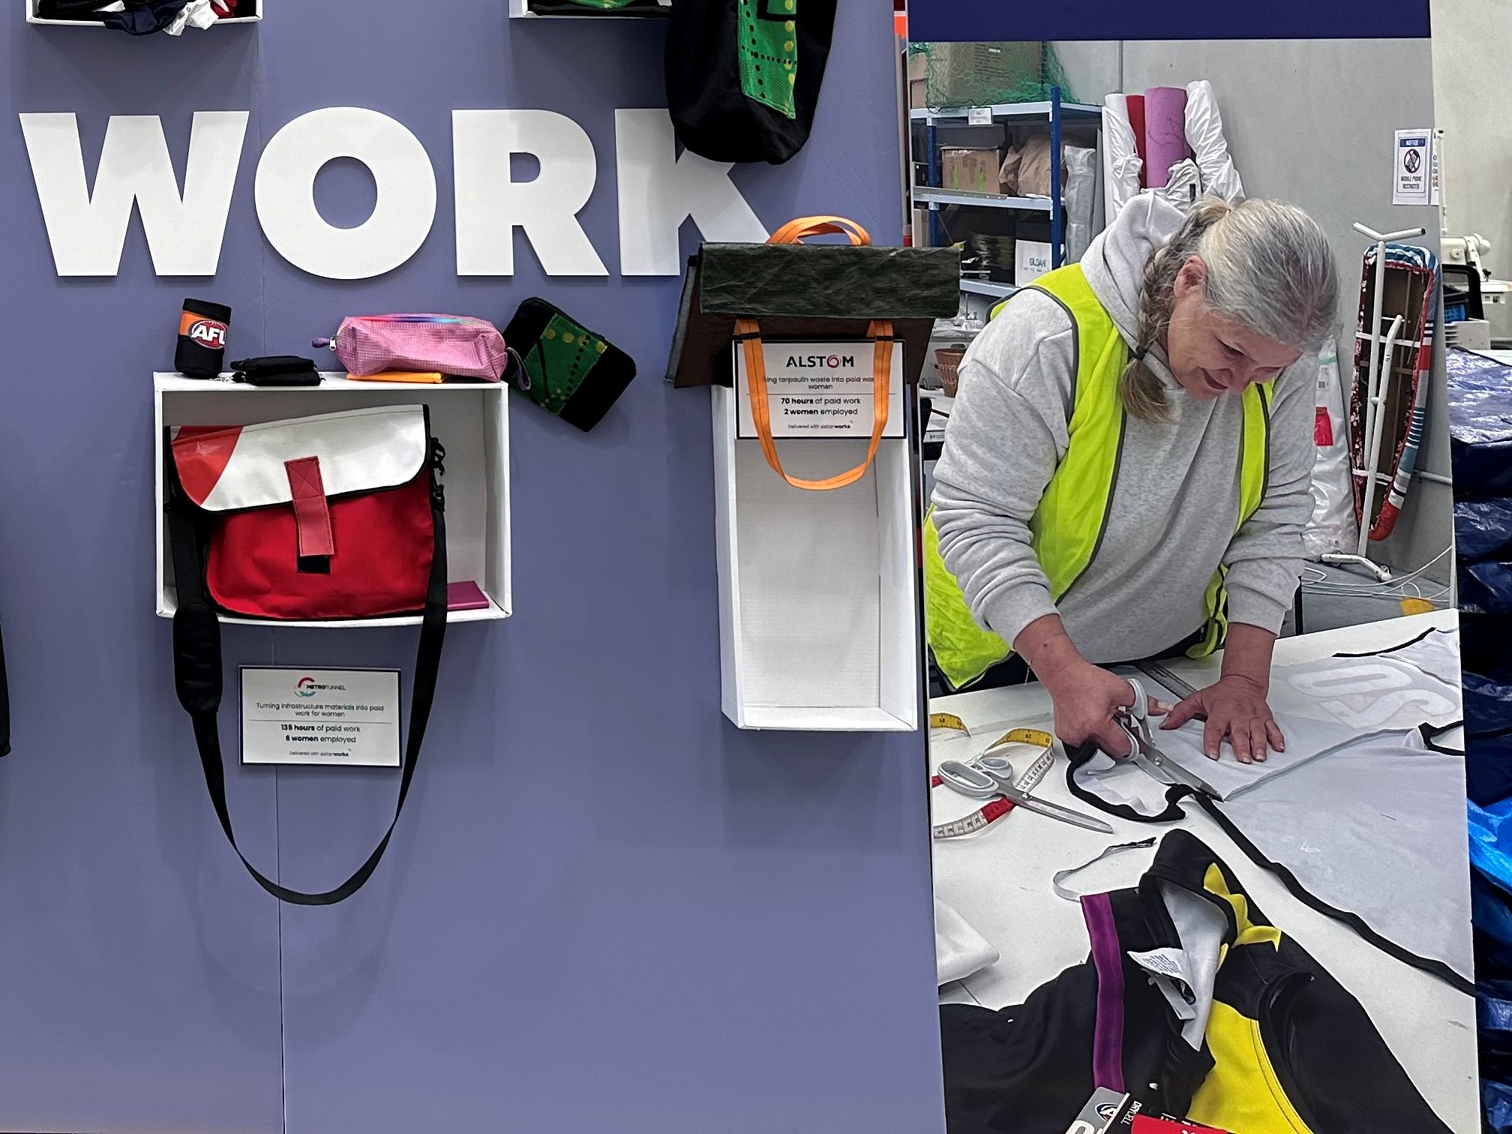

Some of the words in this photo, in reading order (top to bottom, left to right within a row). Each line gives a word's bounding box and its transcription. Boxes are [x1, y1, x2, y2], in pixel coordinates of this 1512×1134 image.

[20, 107, 771, 279] WORK
[191, 325, 225, 345] AFL
[786, 355, 854, 368] ALSTOM
[326, 725, 341, 733] paid
